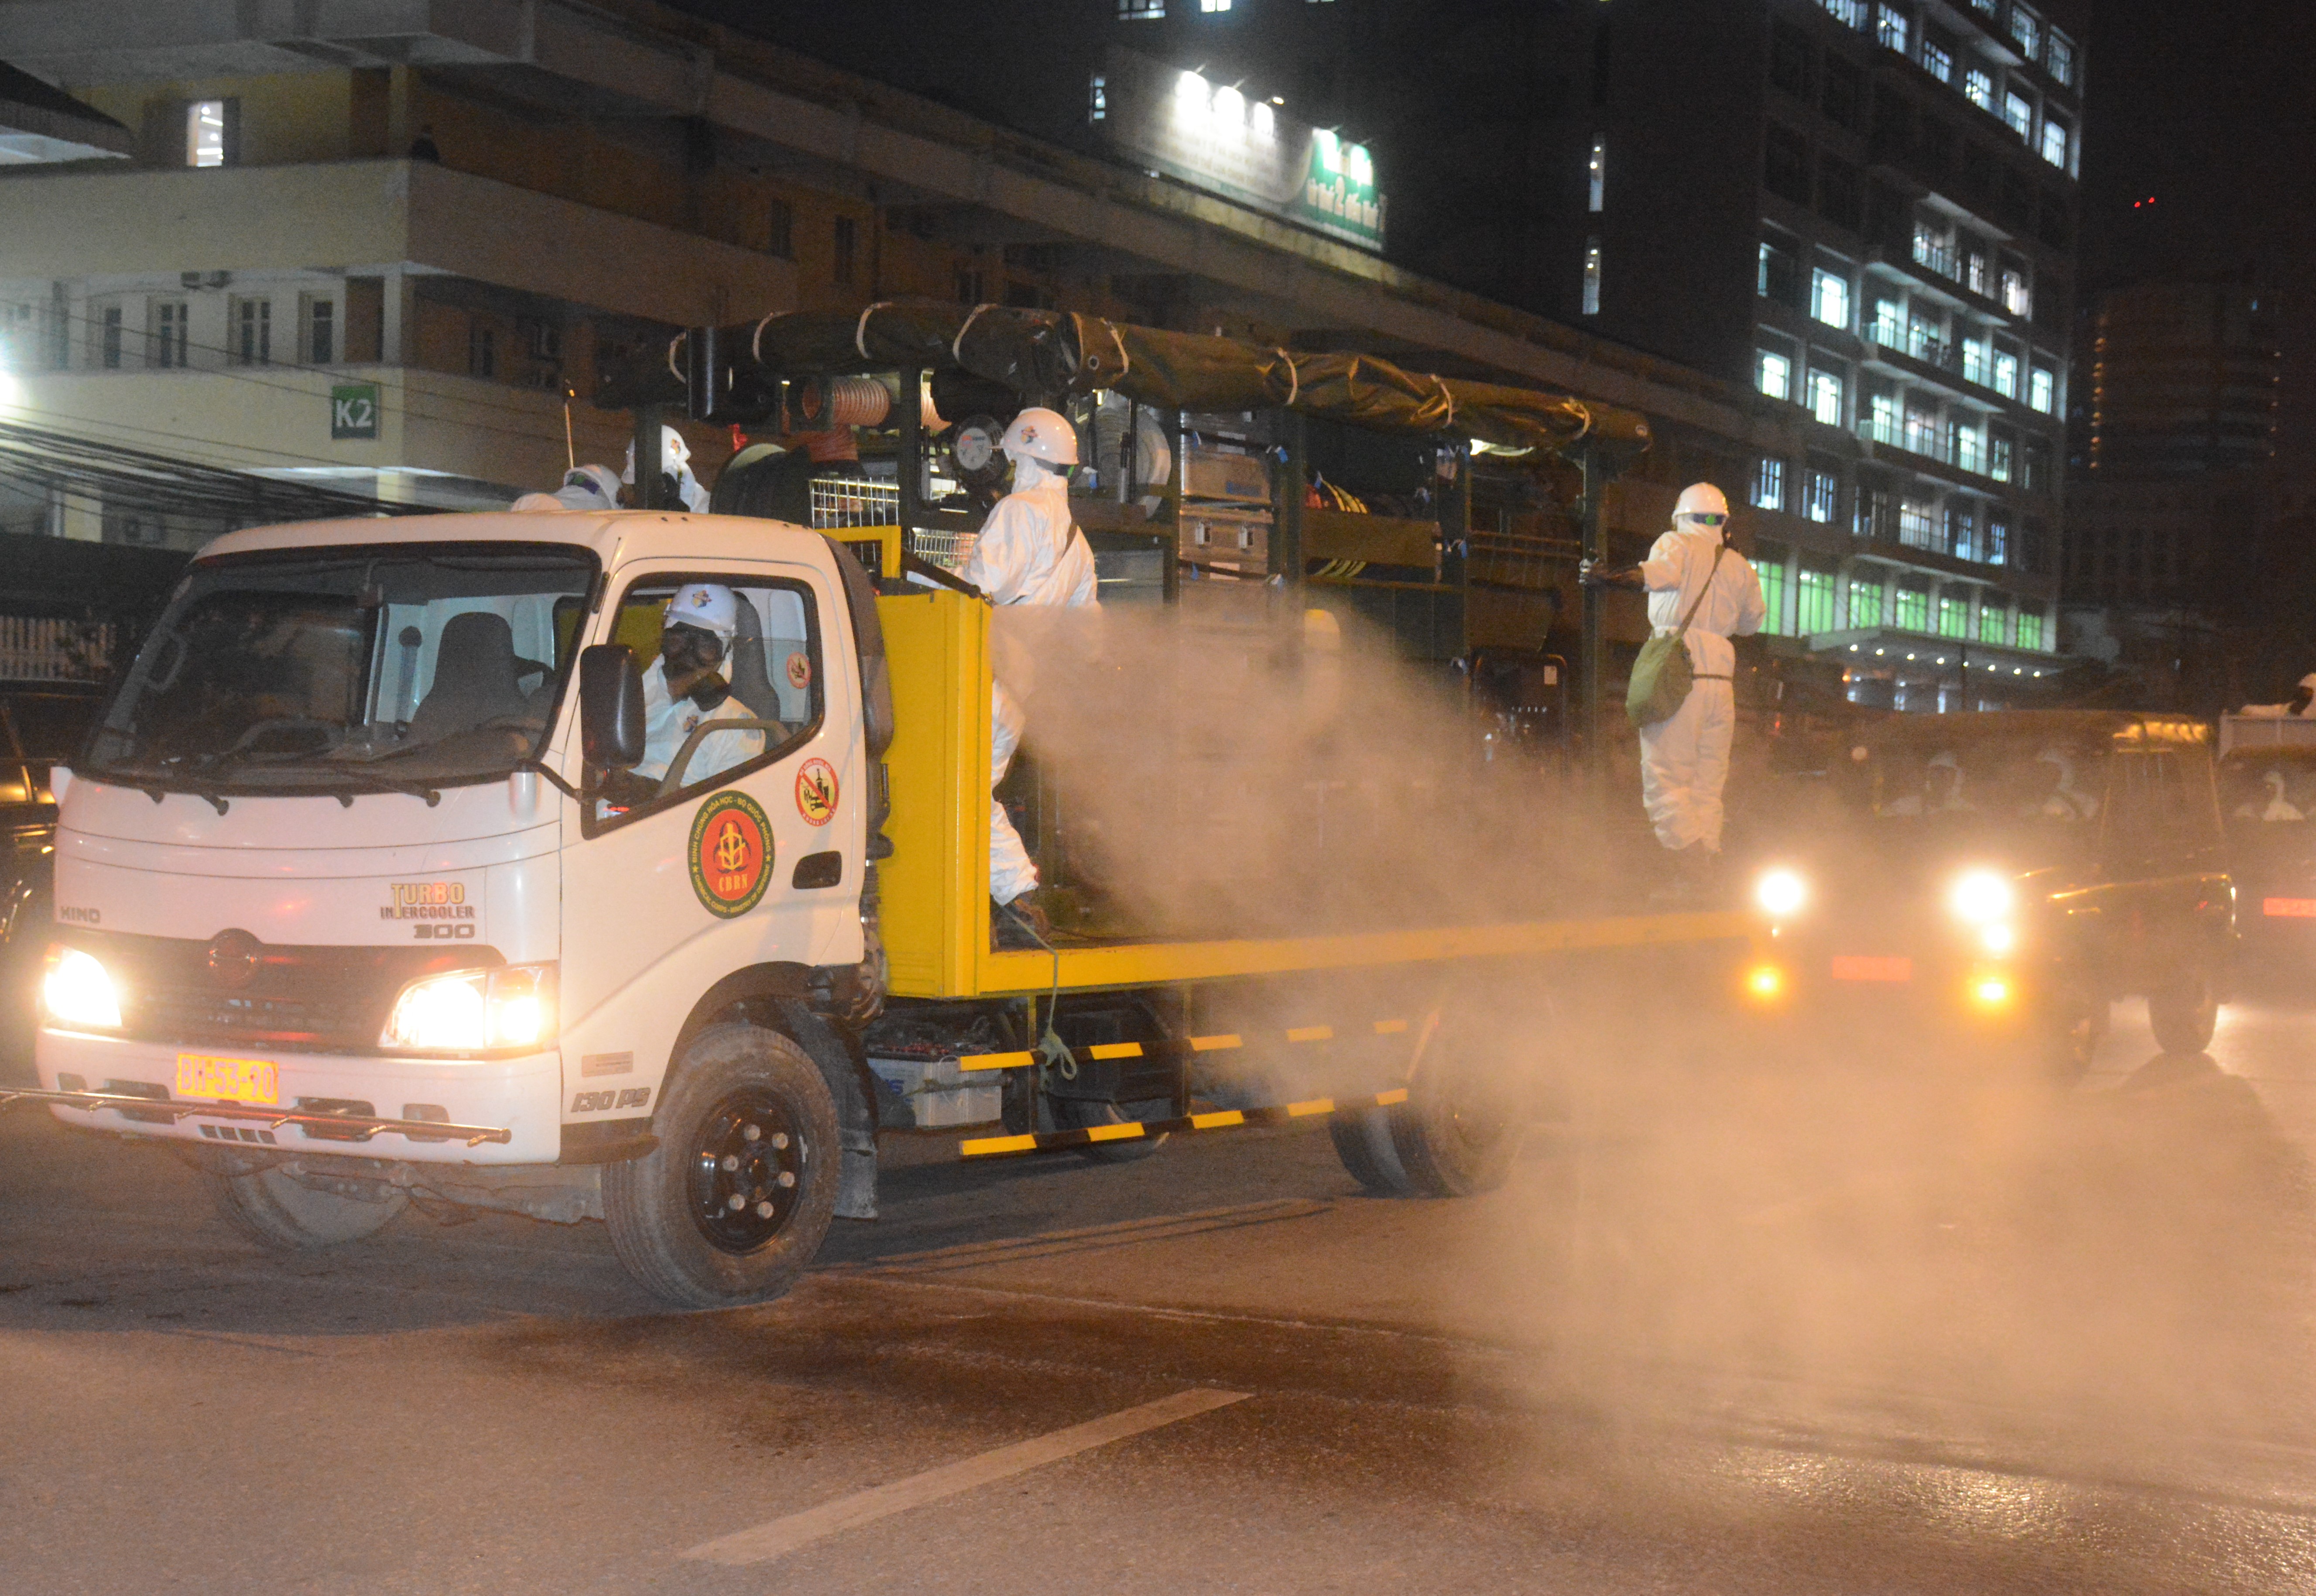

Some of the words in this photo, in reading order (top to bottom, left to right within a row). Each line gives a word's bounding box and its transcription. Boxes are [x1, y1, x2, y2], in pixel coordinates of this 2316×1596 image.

[336, 398, 372, 428] K2
[719, 873, 748, 892] CBRN
[391, 882, 465, 915] TURBO
[60, 905, 101, 924] HINO
[380, 905, 475, 919] INTERCOOLER
[571, 1091, 616, 1113] 130
